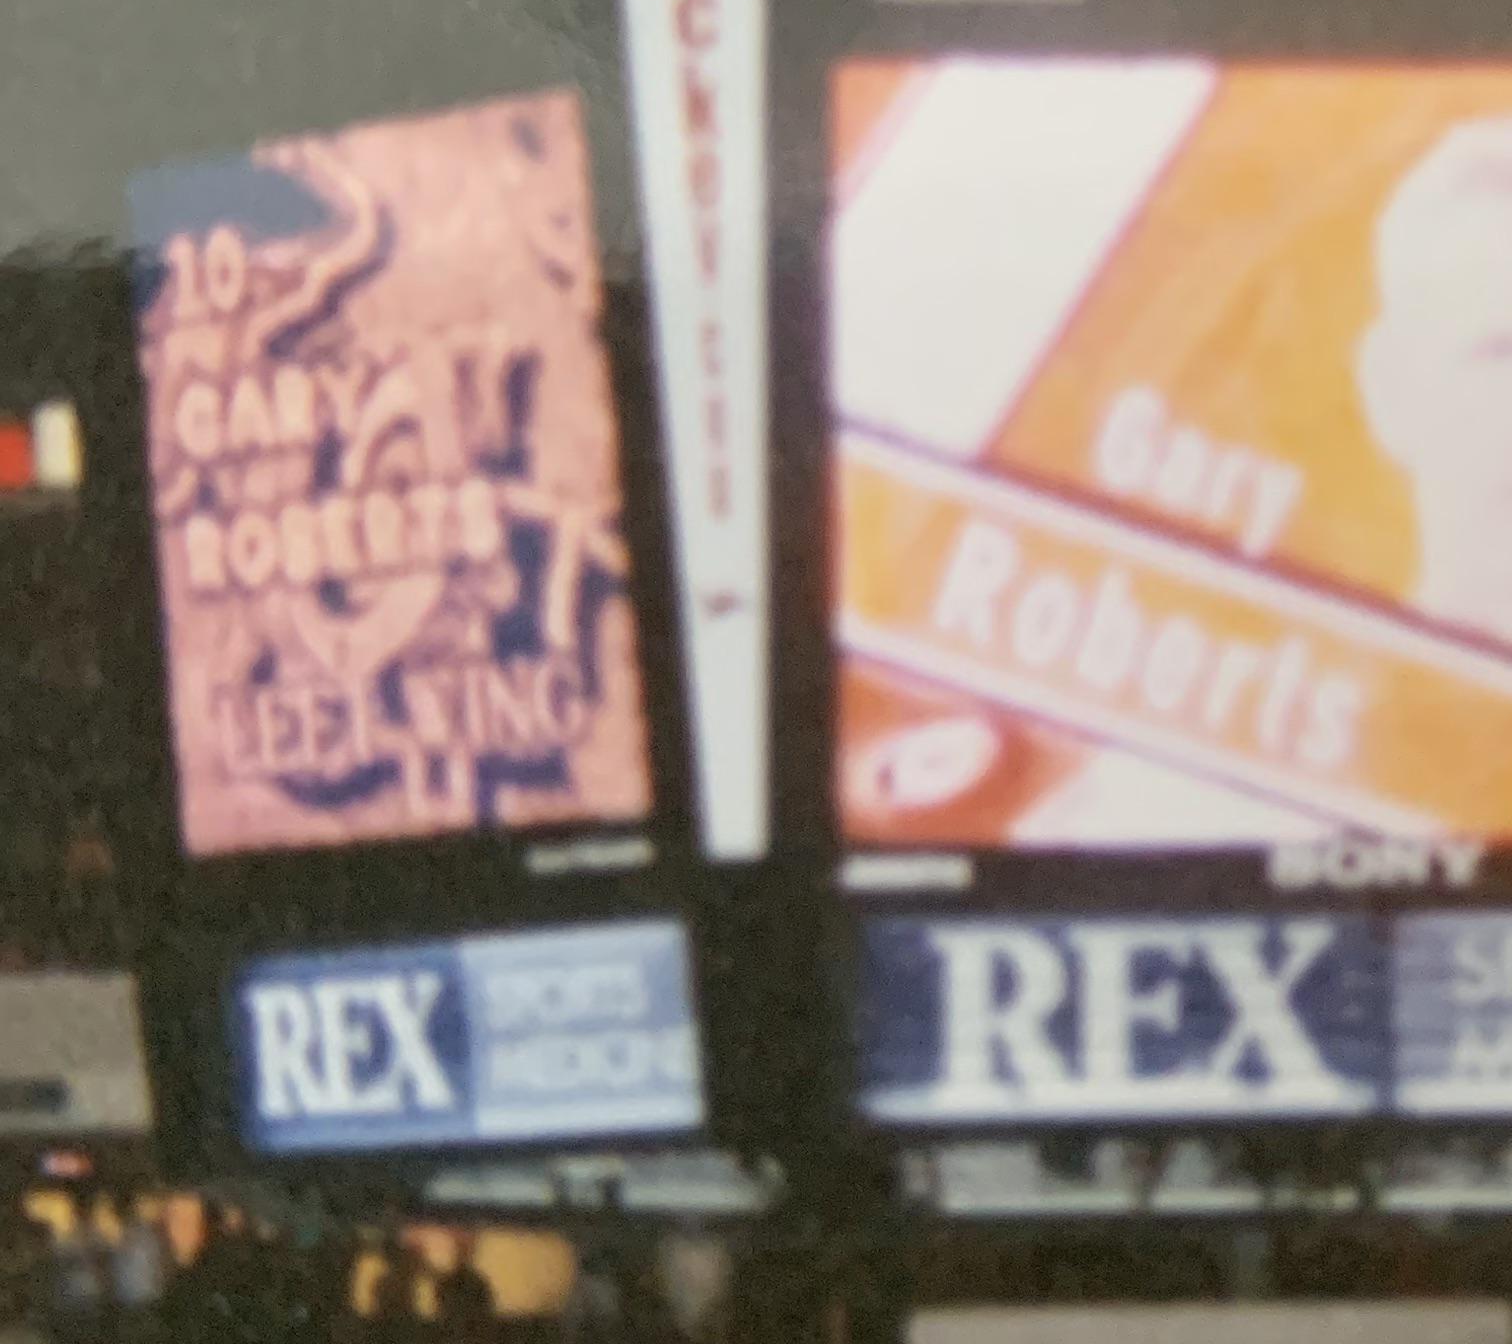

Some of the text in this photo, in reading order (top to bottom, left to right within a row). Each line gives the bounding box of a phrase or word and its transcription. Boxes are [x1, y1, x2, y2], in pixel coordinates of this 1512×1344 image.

[165, 225, 246, 316] 10
[1095, 382, 1305, 560] Gary
[932, 519, 1362, 768] Roberts
[248, 968, 460, 1118] REX
[926, 918, 1350, 1106] REX
